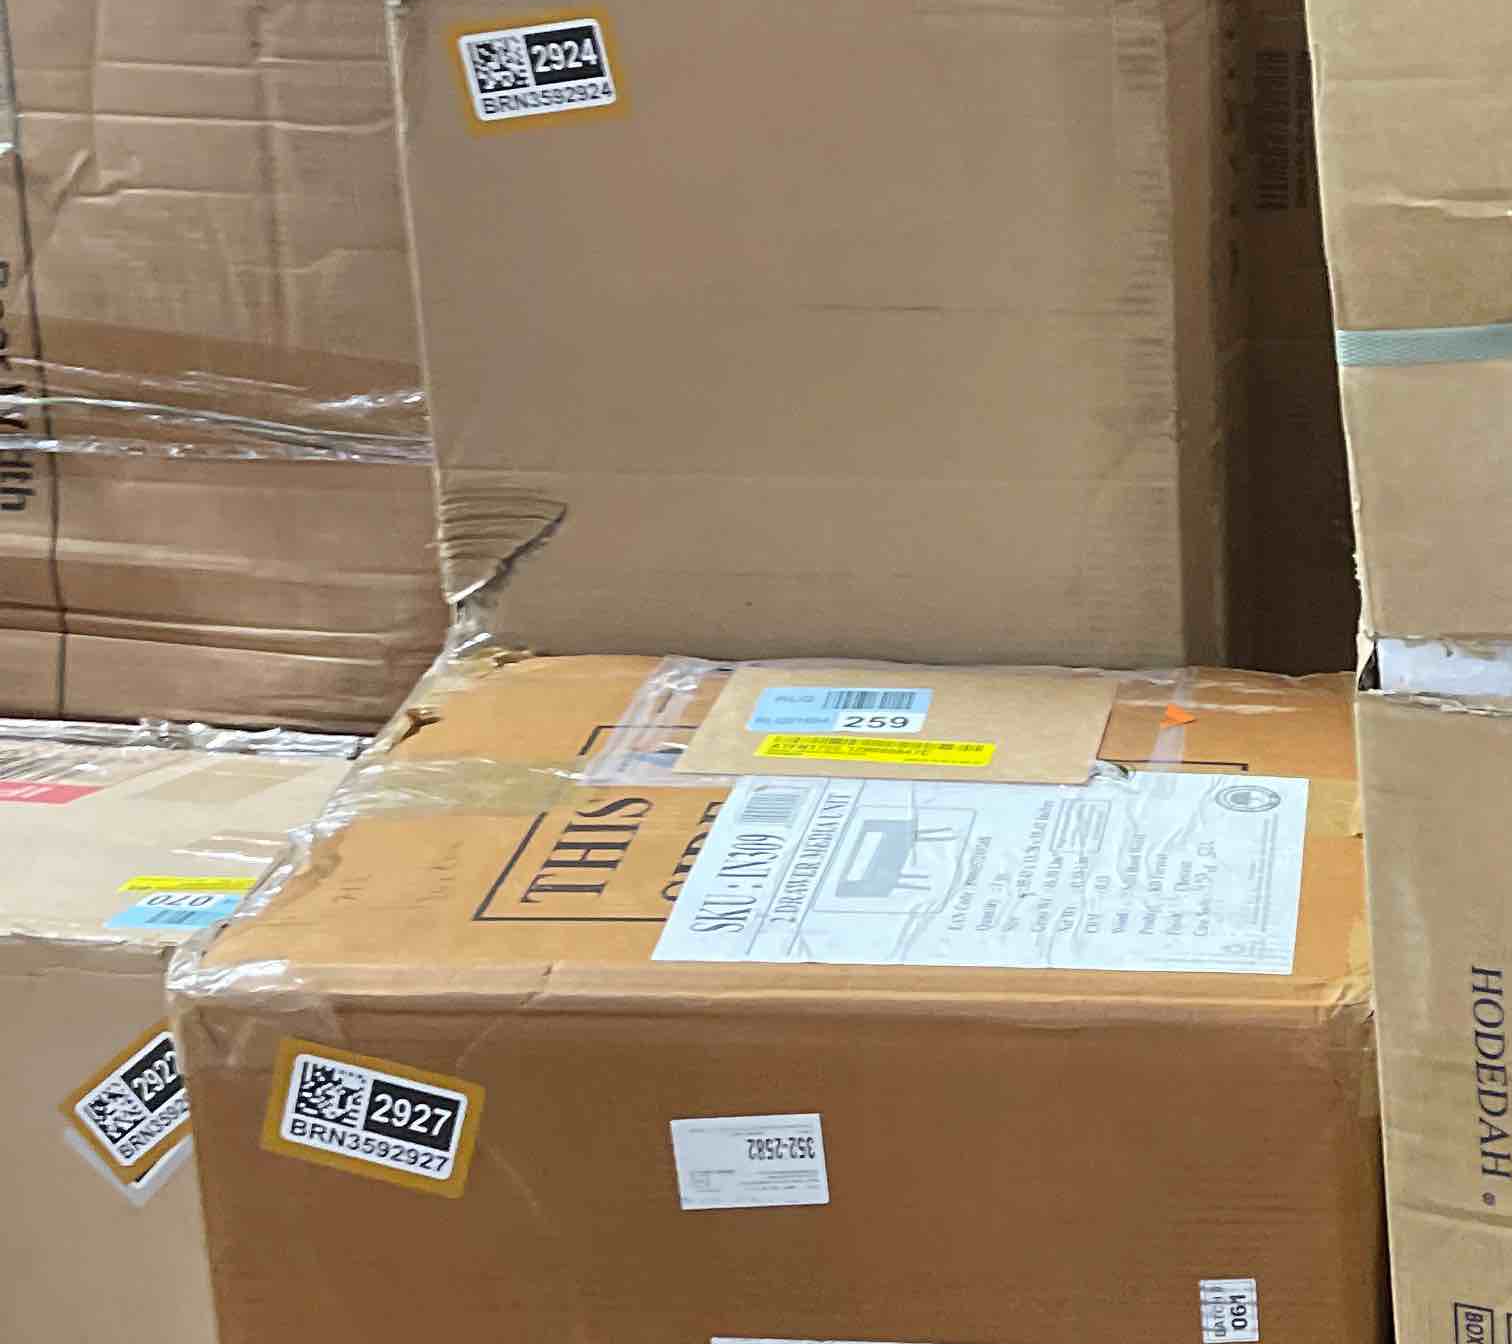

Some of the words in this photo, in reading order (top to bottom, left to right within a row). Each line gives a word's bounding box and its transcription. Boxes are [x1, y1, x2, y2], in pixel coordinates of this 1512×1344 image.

[531, 37, 598, 73] 2924
[843, 716, 910, 729] 259
[521, 796, 654, 906] THIS
[714, 834, 785, 879] IN309
[146, 895, 213, 907] 070
[689, 894, 758, 933] SKU
[1471, 964, 1512, 1179] HODEDAH
[372, 1092, 453, 1136] 2927
[289, 1117, 450, 1175] BRN3592927
